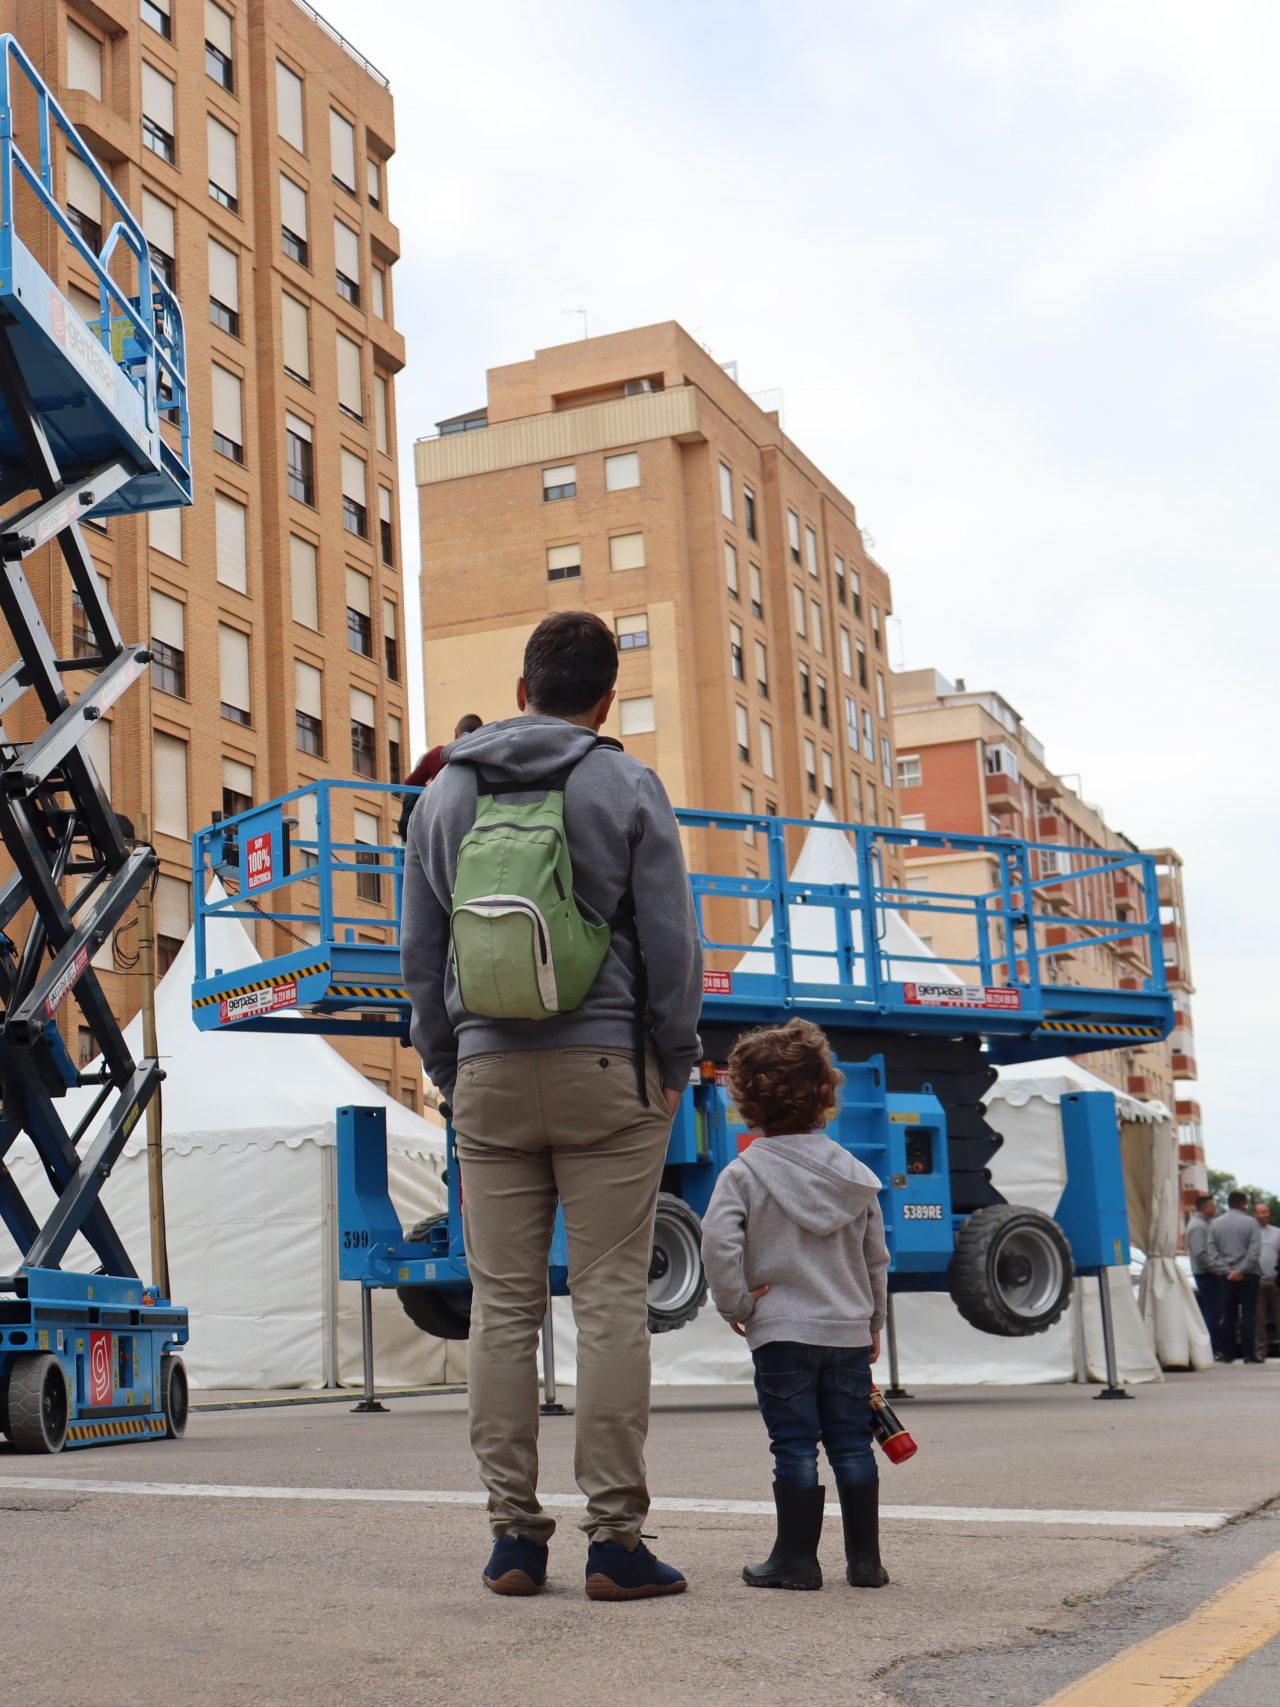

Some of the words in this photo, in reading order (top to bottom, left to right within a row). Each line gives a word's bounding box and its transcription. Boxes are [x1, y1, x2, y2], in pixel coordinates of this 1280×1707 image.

[254, 837, 263, 849] SOY
[248, 847, 271, 874] 100%
[917, 984, 963, 997] gerpasa
[228, 993, 258, 1012] gerpasa
[344, 1231, 369, 1249] 399
[92, 1335, 110, 1402] g
